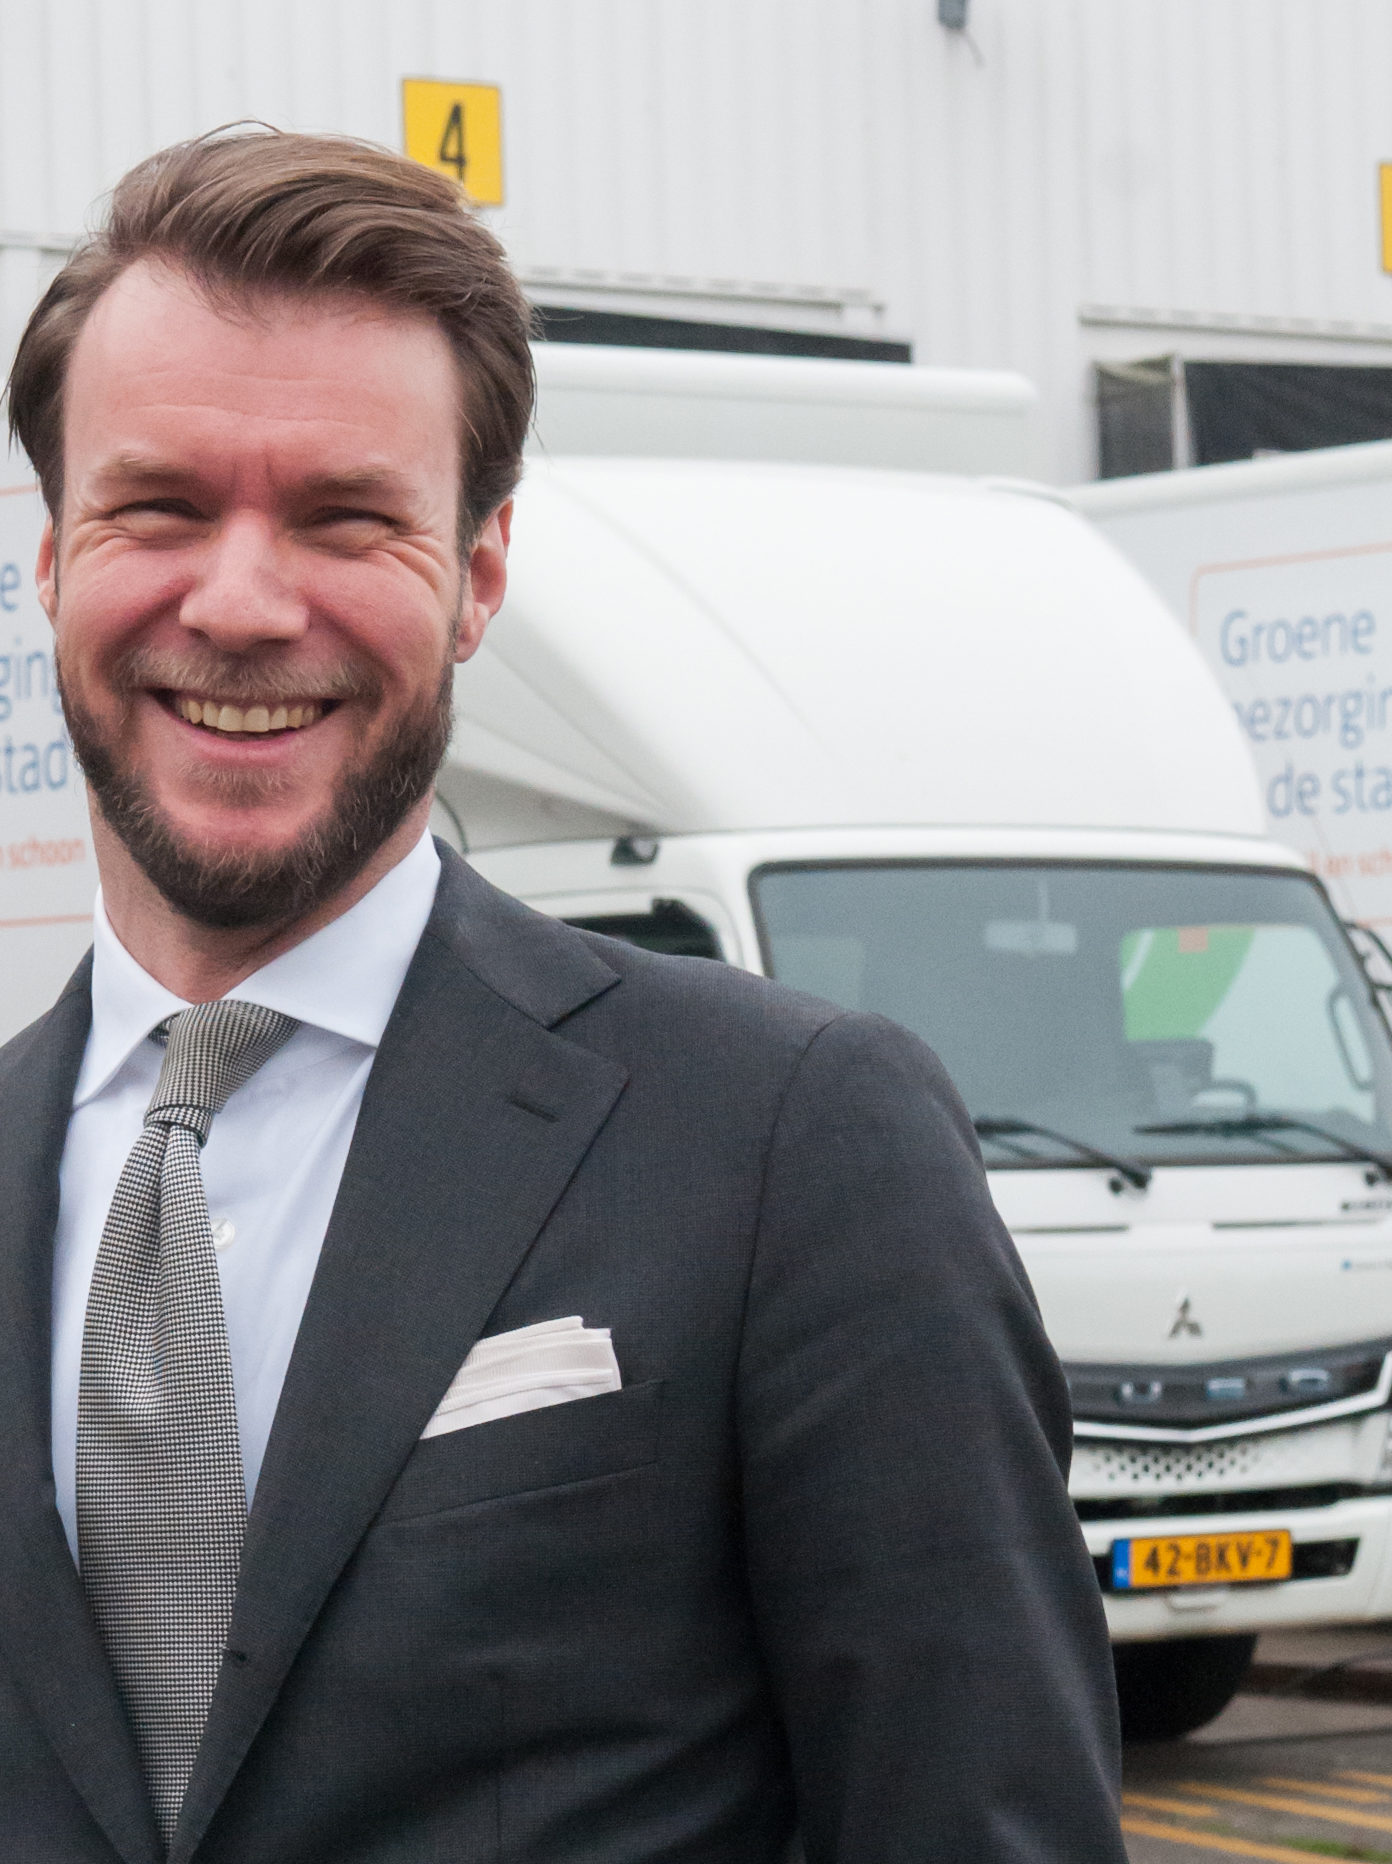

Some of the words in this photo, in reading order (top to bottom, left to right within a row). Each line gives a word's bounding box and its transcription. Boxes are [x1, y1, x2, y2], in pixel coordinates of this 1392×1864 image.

[439, 102, 467, 181] 4
[1220, 609, 1377, 667] Groene
[1268, 757, 1322, 818] de
[1144, 1535, 1281, 1577] 42-BKV-7
